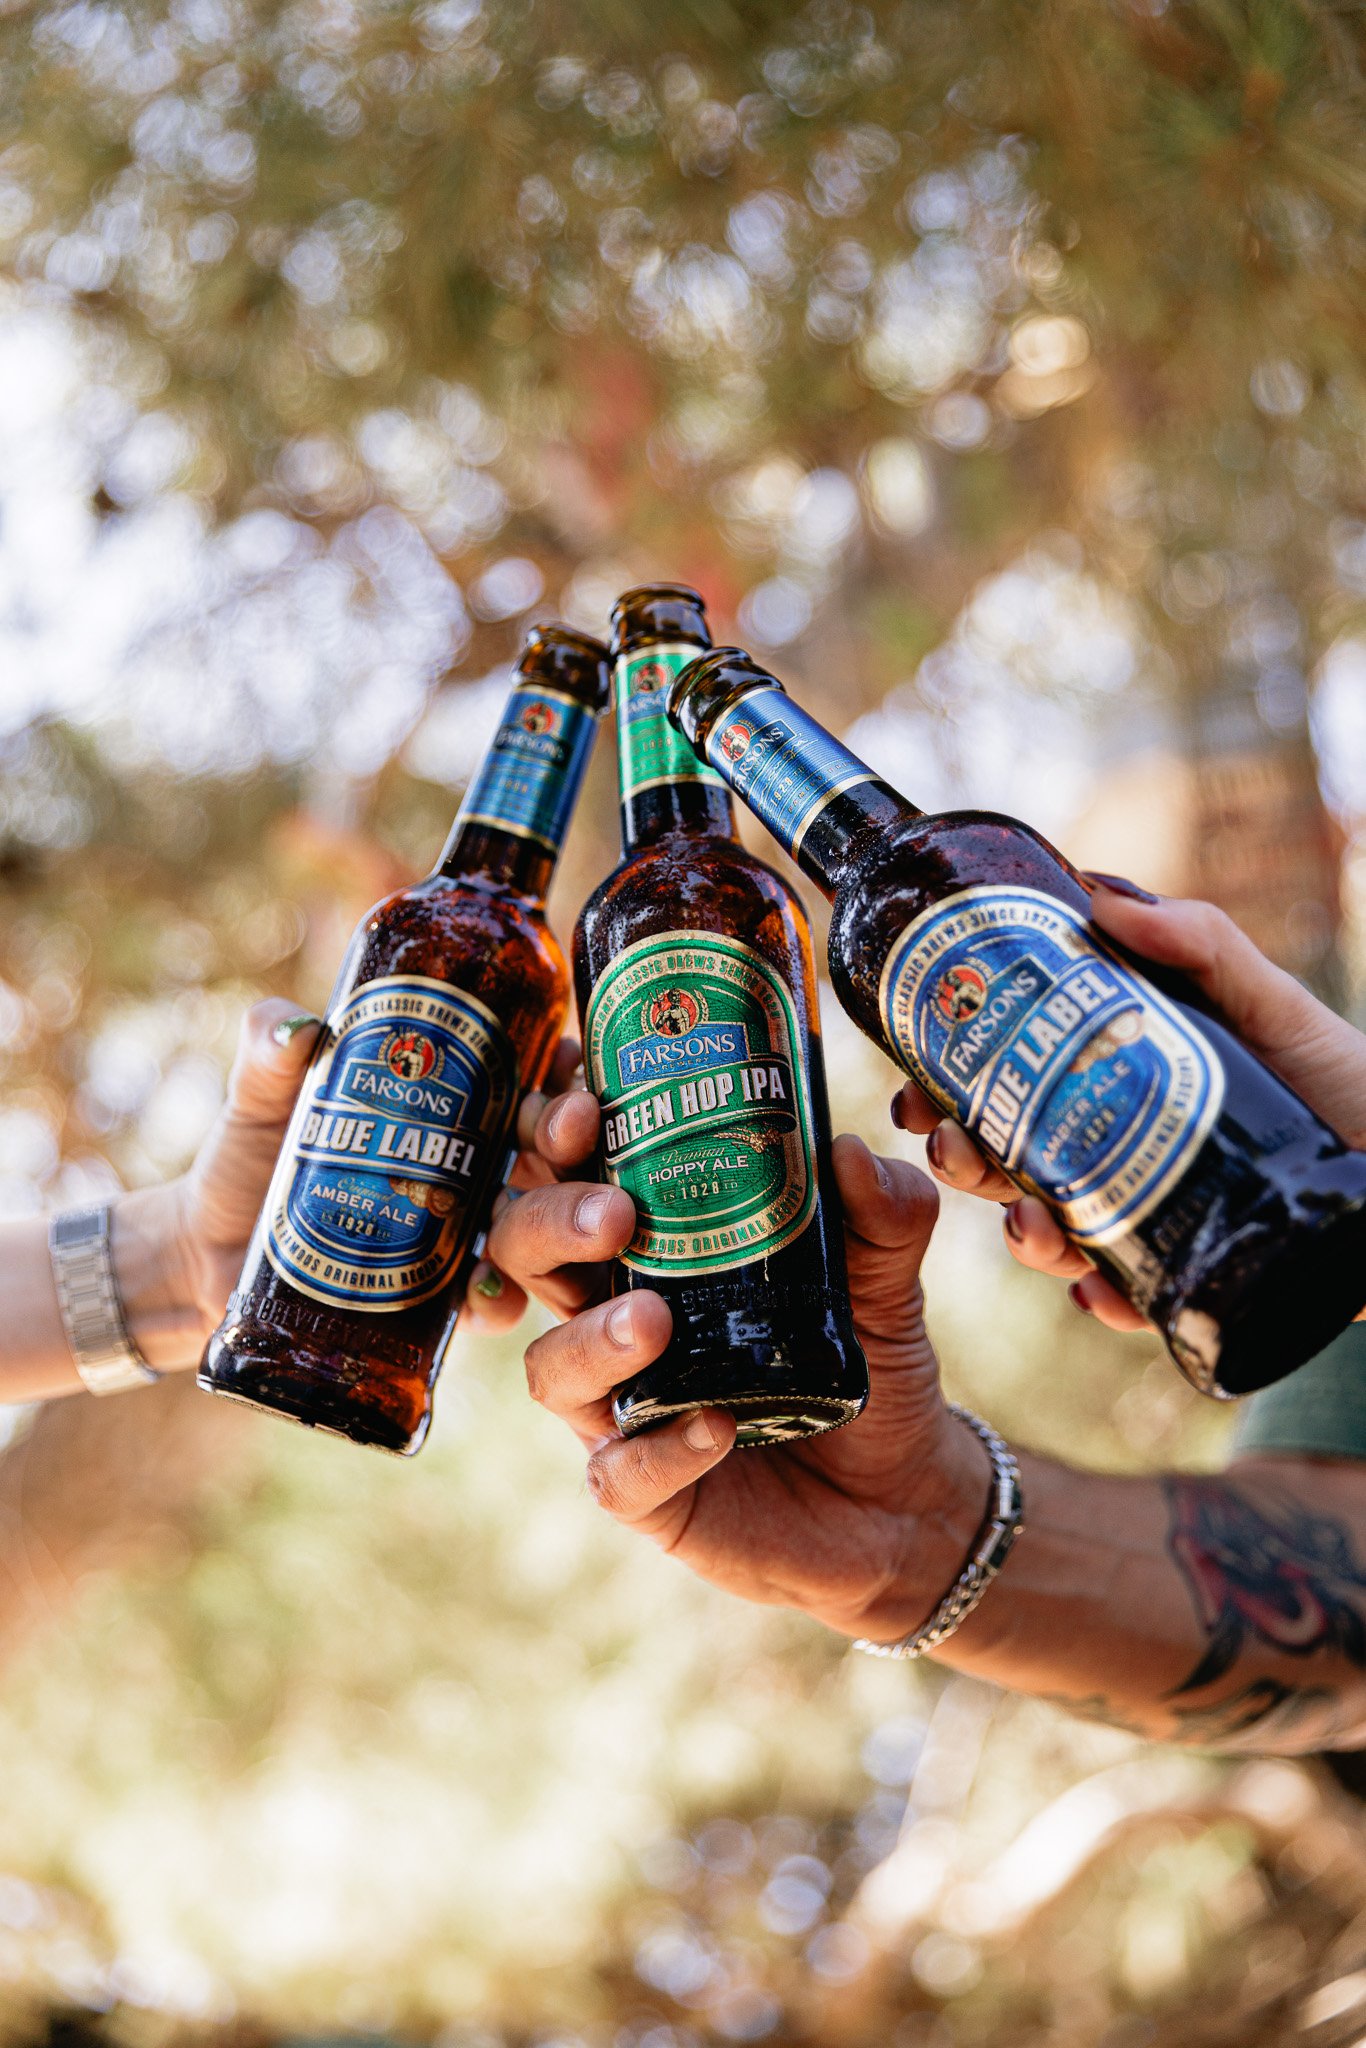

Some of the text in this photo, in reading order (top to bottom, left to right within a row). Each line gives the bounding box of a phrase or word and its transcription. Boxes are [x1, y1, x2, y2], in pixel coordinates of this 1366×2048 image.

[734, 727, 784, 793] FARSONS
[771, 778, 793, 807] 1928
[971, 909, 1017, 927] SINCE
[615, 960, 663, 997] CLASSIC
[667, 955, 716, 970] BREWS
[374, 999, 423, 1014] CLASSIC
[428, 1004, 471, 1035] BREWS
[950, 969, 1038, 1073] FARSONS
[628, 1034, 736, 1073] FARSONS
[979, 1061, 1031, 1156] BLUE
[1013, 969, 1120, 1074] LABEL
[351, 1068, 453, 1117] FARSONS
[1092, 1060, 1132, 1100] ALE
[605, 1067, 786, 1152] GREEN HOP IPA
[300, 1112, 476, 1177] BLUE LABEL
[648, 1155, 748, 1185] HOPPY ALE
[310, 1183, 418, 1227] AMBER ALE
[681, 1182, 720, 1200] 1928
[338, 1215, 374, 1237] 1928
[692, 1220, 765, 1252] ORIGINAL
[324, 1265, 395, 1288] ORIGINAL
